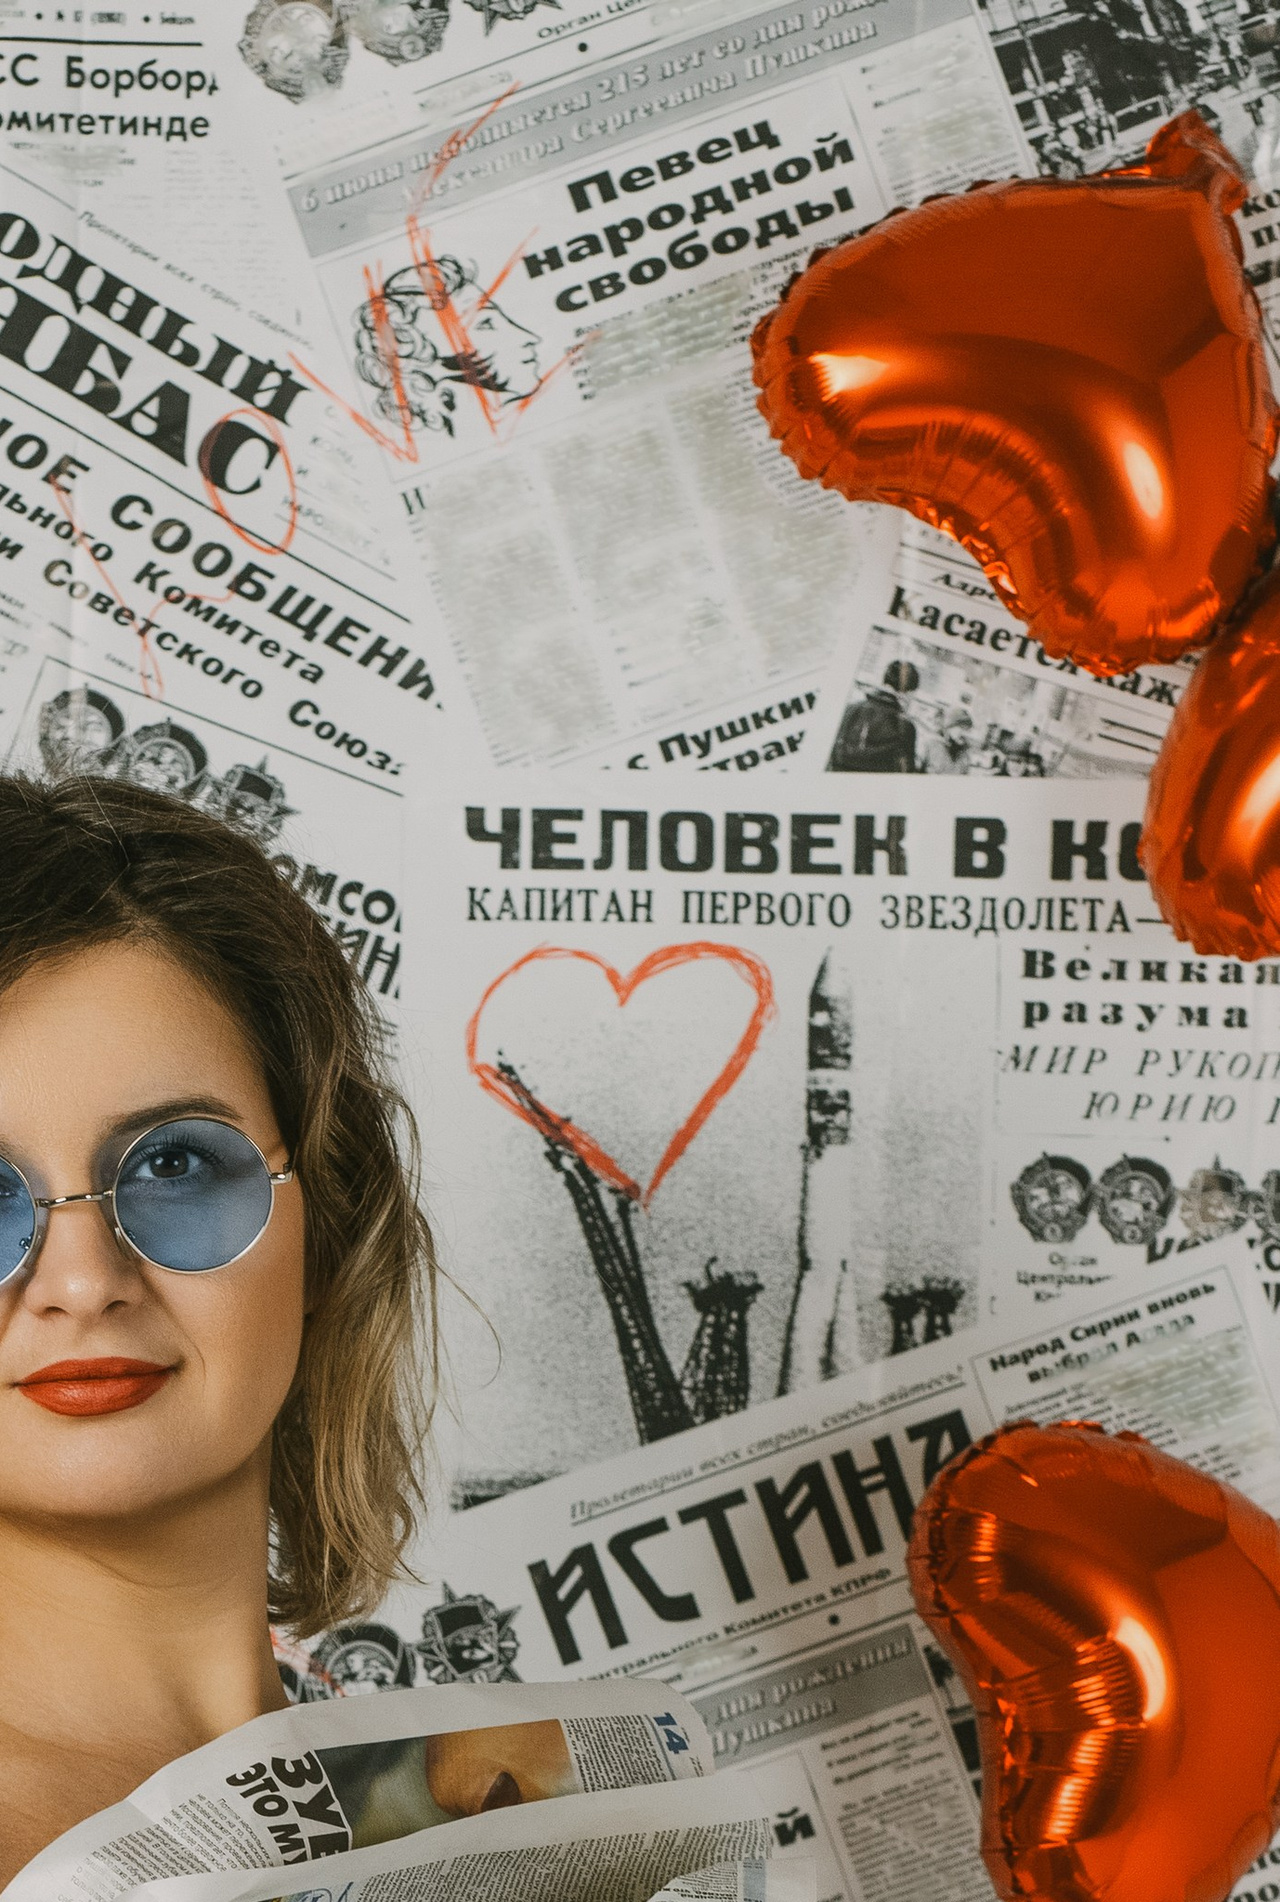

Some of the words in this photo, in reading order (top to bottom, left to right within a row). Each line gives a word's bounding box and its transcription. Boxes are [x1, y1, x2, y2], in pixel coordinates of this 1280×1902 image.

[536, 9, 602, 40] Орган
[595, 68, 650, 104] 215
[752, 12, 812, 55] дня
[743, 17, 878, 82] Пушкина
[566, 118, 782, 213] Певец
[519, 131, 856, 280] народной
[552, 185, 858, 316] свободы
[43, 558, 264, 700] Советского
[109, 493, 444, 712] СООБЩЕНИ
[132, 561, 325, 685] Комитета
[465, 806, 908, 878] ЧЕЛОВЕК
[953, 816, 1008, 879] В
[466, 887, 656, 923] КАПИТАН
[682, 890, 853, 928] ПЕРВОГО
[1022, 948, 1280, 985] Великая
[1022, 999, 1250, 1033] разума
[1082, 1091, 1237, 1125] ЮРИЮ
[989, 1334, 1066, 1374] Народ
[1069, 1307, 1141, 1343] Сирии
[1146, 1282, 1218, 1316] вновь
[721, 1592, 827, 1636] Комитета
[829, 1567, 893, 1597] КПРФ
[652, 1711, 690, 1755] 14
[225, 1761, 290, 1819] ЭТО
